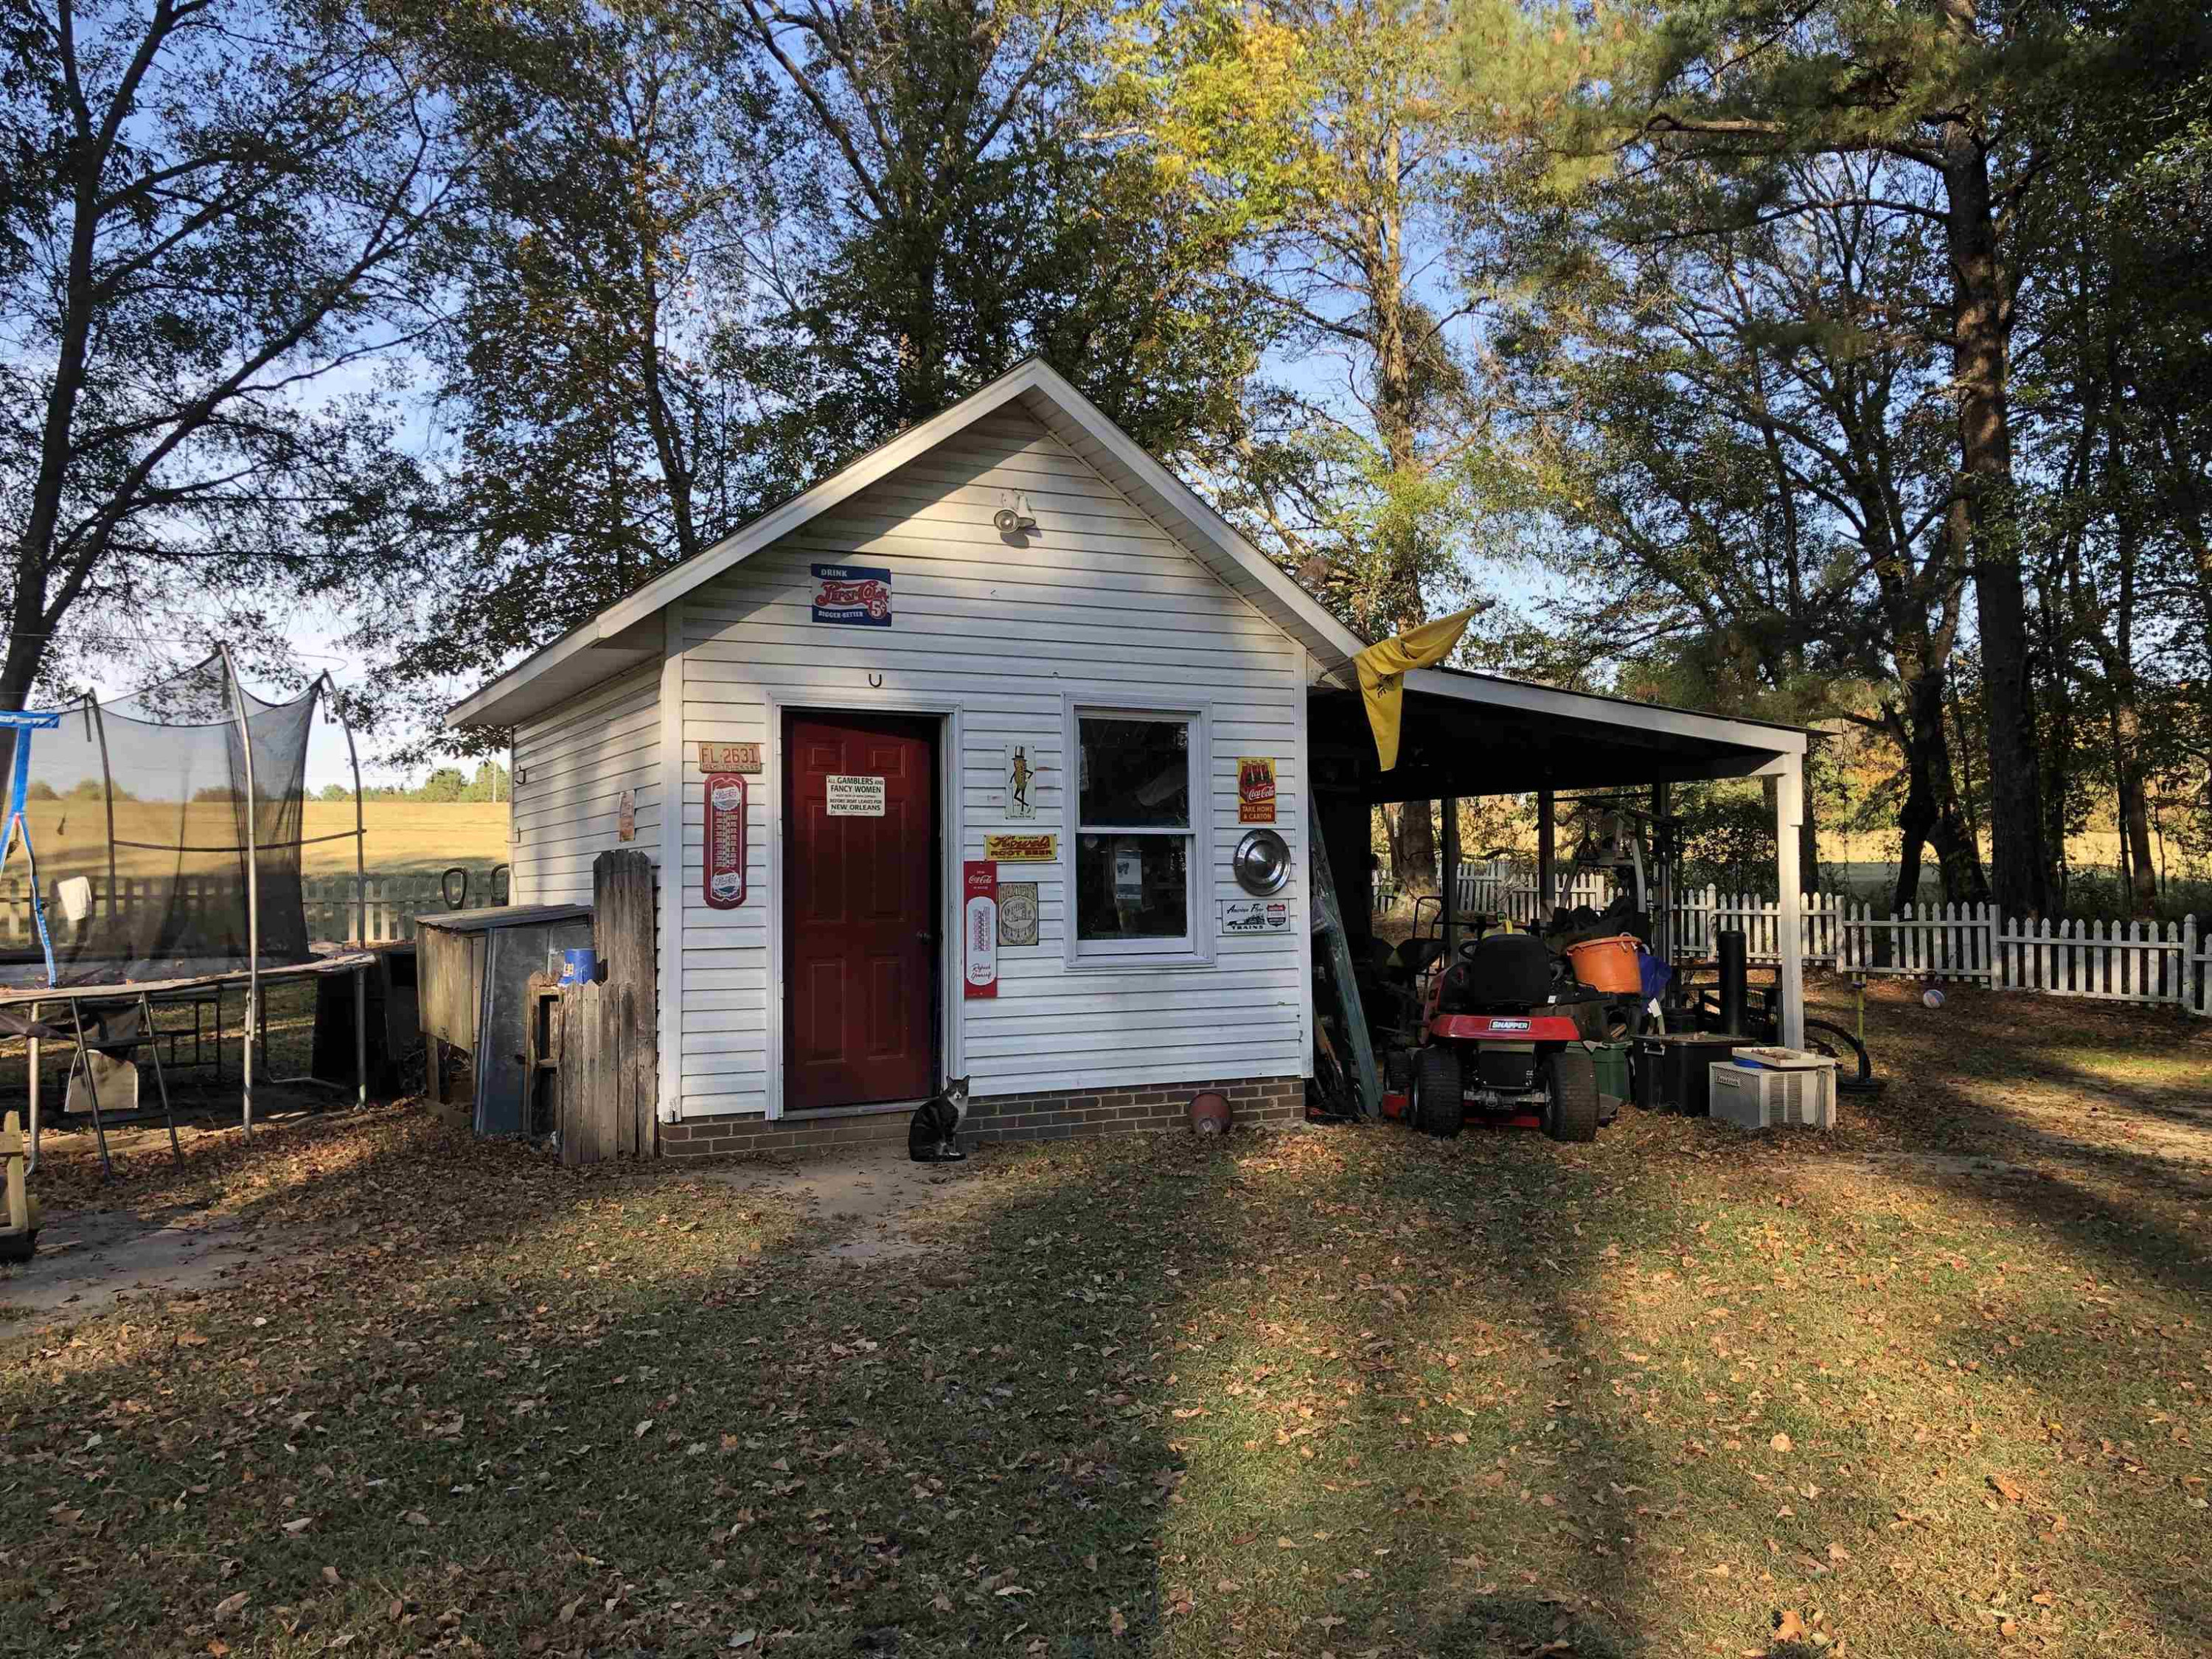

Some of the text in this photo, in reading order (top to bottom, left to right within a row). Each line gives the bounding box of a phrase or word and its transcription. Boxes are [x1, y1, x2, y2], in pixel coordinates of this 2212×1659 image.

[821, 568, 847, 577] DRINK
[723, 748, 758, 763] 2631
[837, 776, 873, 785] GAMBLERS
[830, 785, 852, 793] FANCY
[1492, 1020, 1528, 1029] SNAPPER
